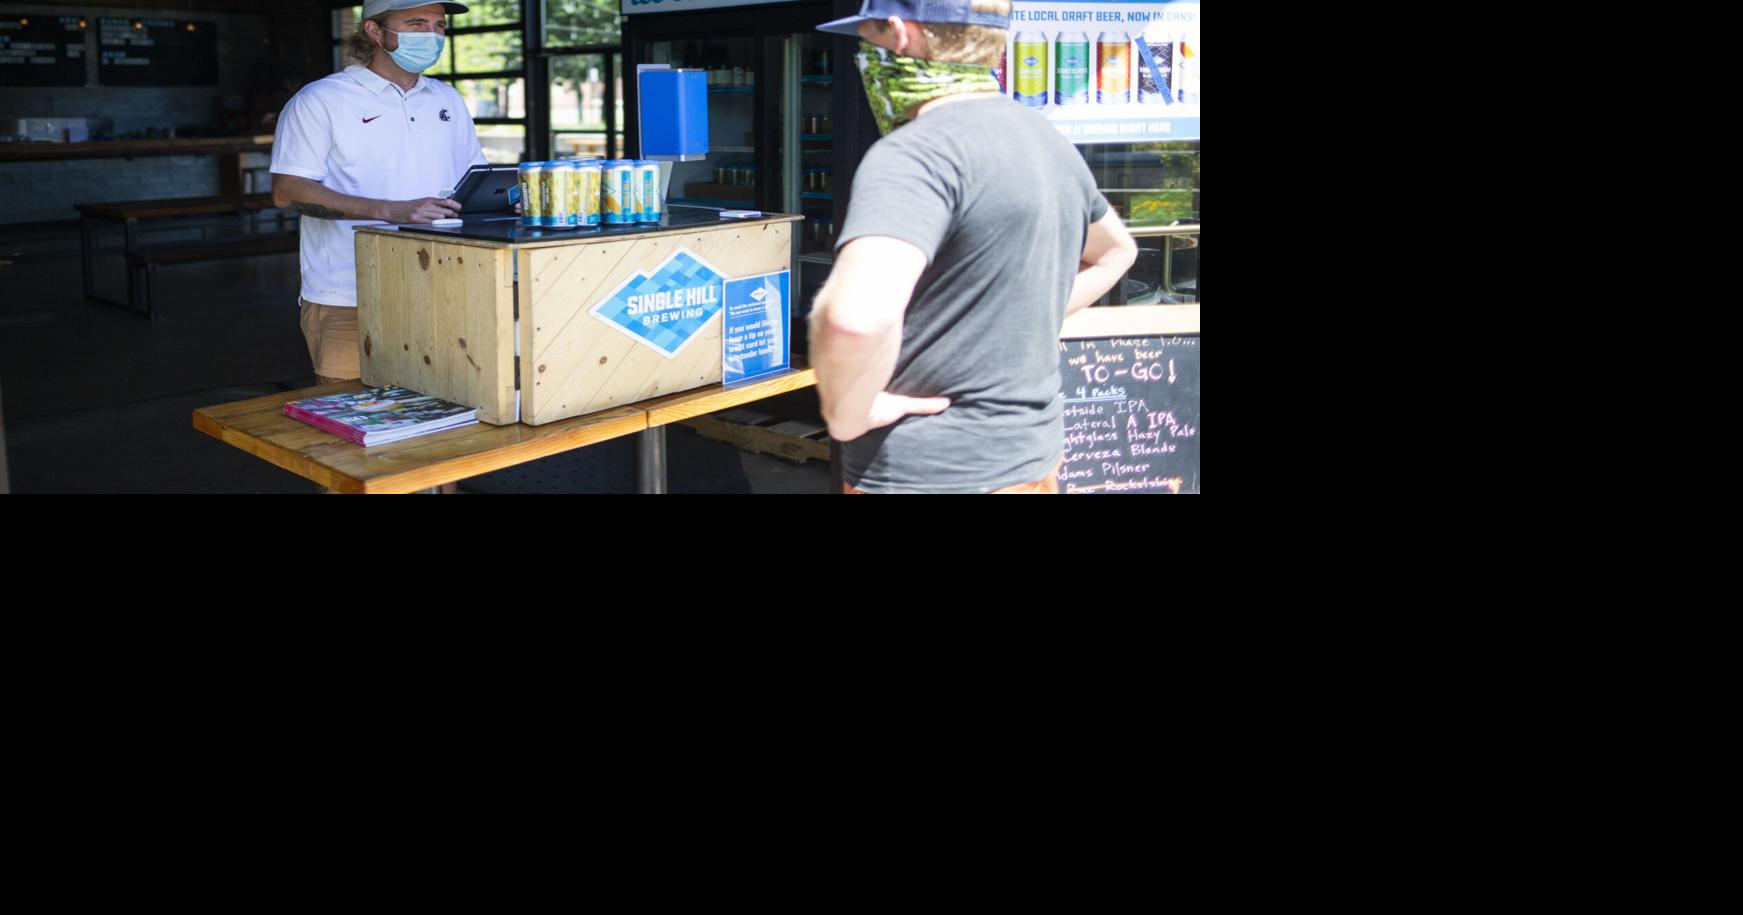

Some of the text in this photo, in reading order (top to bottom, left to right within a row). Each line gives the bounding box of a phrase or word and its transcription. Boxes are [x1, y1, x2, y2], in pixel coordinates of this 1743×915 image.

[1028, 10, 1060, 22] LOCAL
[1062, 11, 1093, 22] DRAFT
[1096, 11, 1125, 23] BEER,
[1127, 11, 1150, 22] NOW
[1152, 11, 1164, 22] IN
[626, 288, 685, 315] SINGLE
[686, 285, 717, 306] HILL
[642, 307, 704, 326] BREWING
[734, 325, 745, 334] you
[745, 320, 761, 331] would
[745, 340, 758, 349] card
[758, 338, 766, 346] let
[748, 331, 756, 341] tip
[1081, 340, 1095, 350] in
[1068, 347, 1163, 366] we have beer
[1076, 386, 1086, 399] 4
[1063, 399, 1149, 417] stside IPA
[1127, 413, 1138, 429] A
[1147, 411, 1177, 429] IPA
[1127, 428, 1161, 445] Hazy
[1170, 424, 1196, 438] Pale
[1130, 441, 1177, 456] Blonde
[1102, 461, 1151, 477] Pilsner
